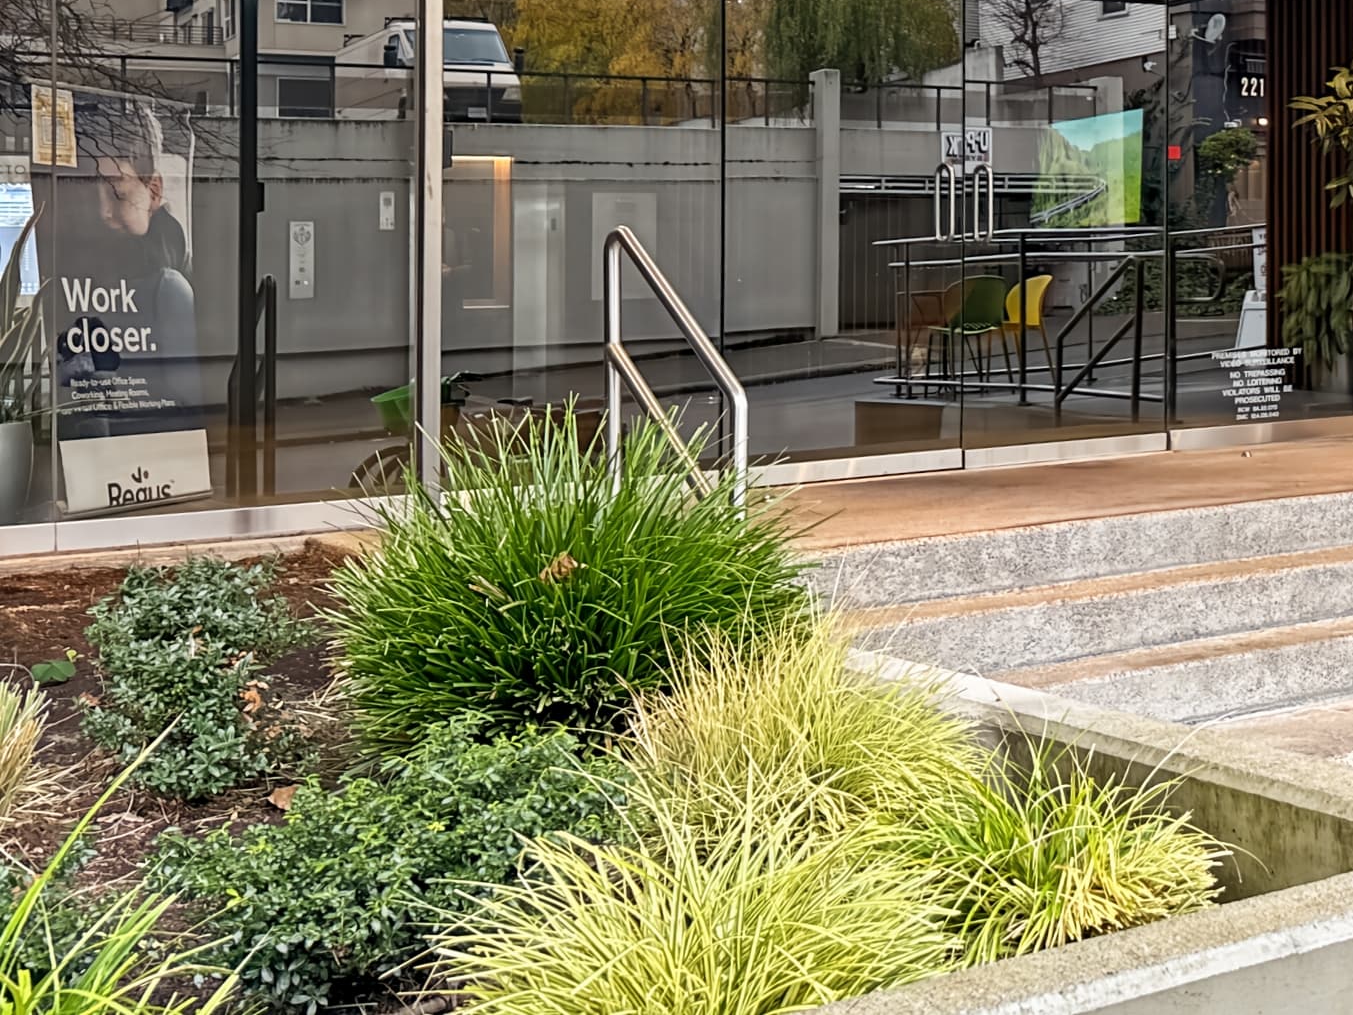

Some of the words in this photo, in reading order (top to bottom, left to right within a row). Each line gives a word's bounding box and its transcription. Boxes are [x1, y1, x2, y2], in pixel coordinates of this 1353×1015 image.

[1241, 76, 1264, 97] 221
[61, 277, 138, 313] Work
[67, 318, 157, 354] closer.
[1293, 347, 1302, 355] BY
[1233, 379, 1244, 387] NO
[1247, 376, 1282, 386] LOITERING
[1222, 387, 1261, 396] VIOLATORS
[1263, 386, 1280, 394] WILL
[1234, 394, 1280, 404] PROSECUTED
